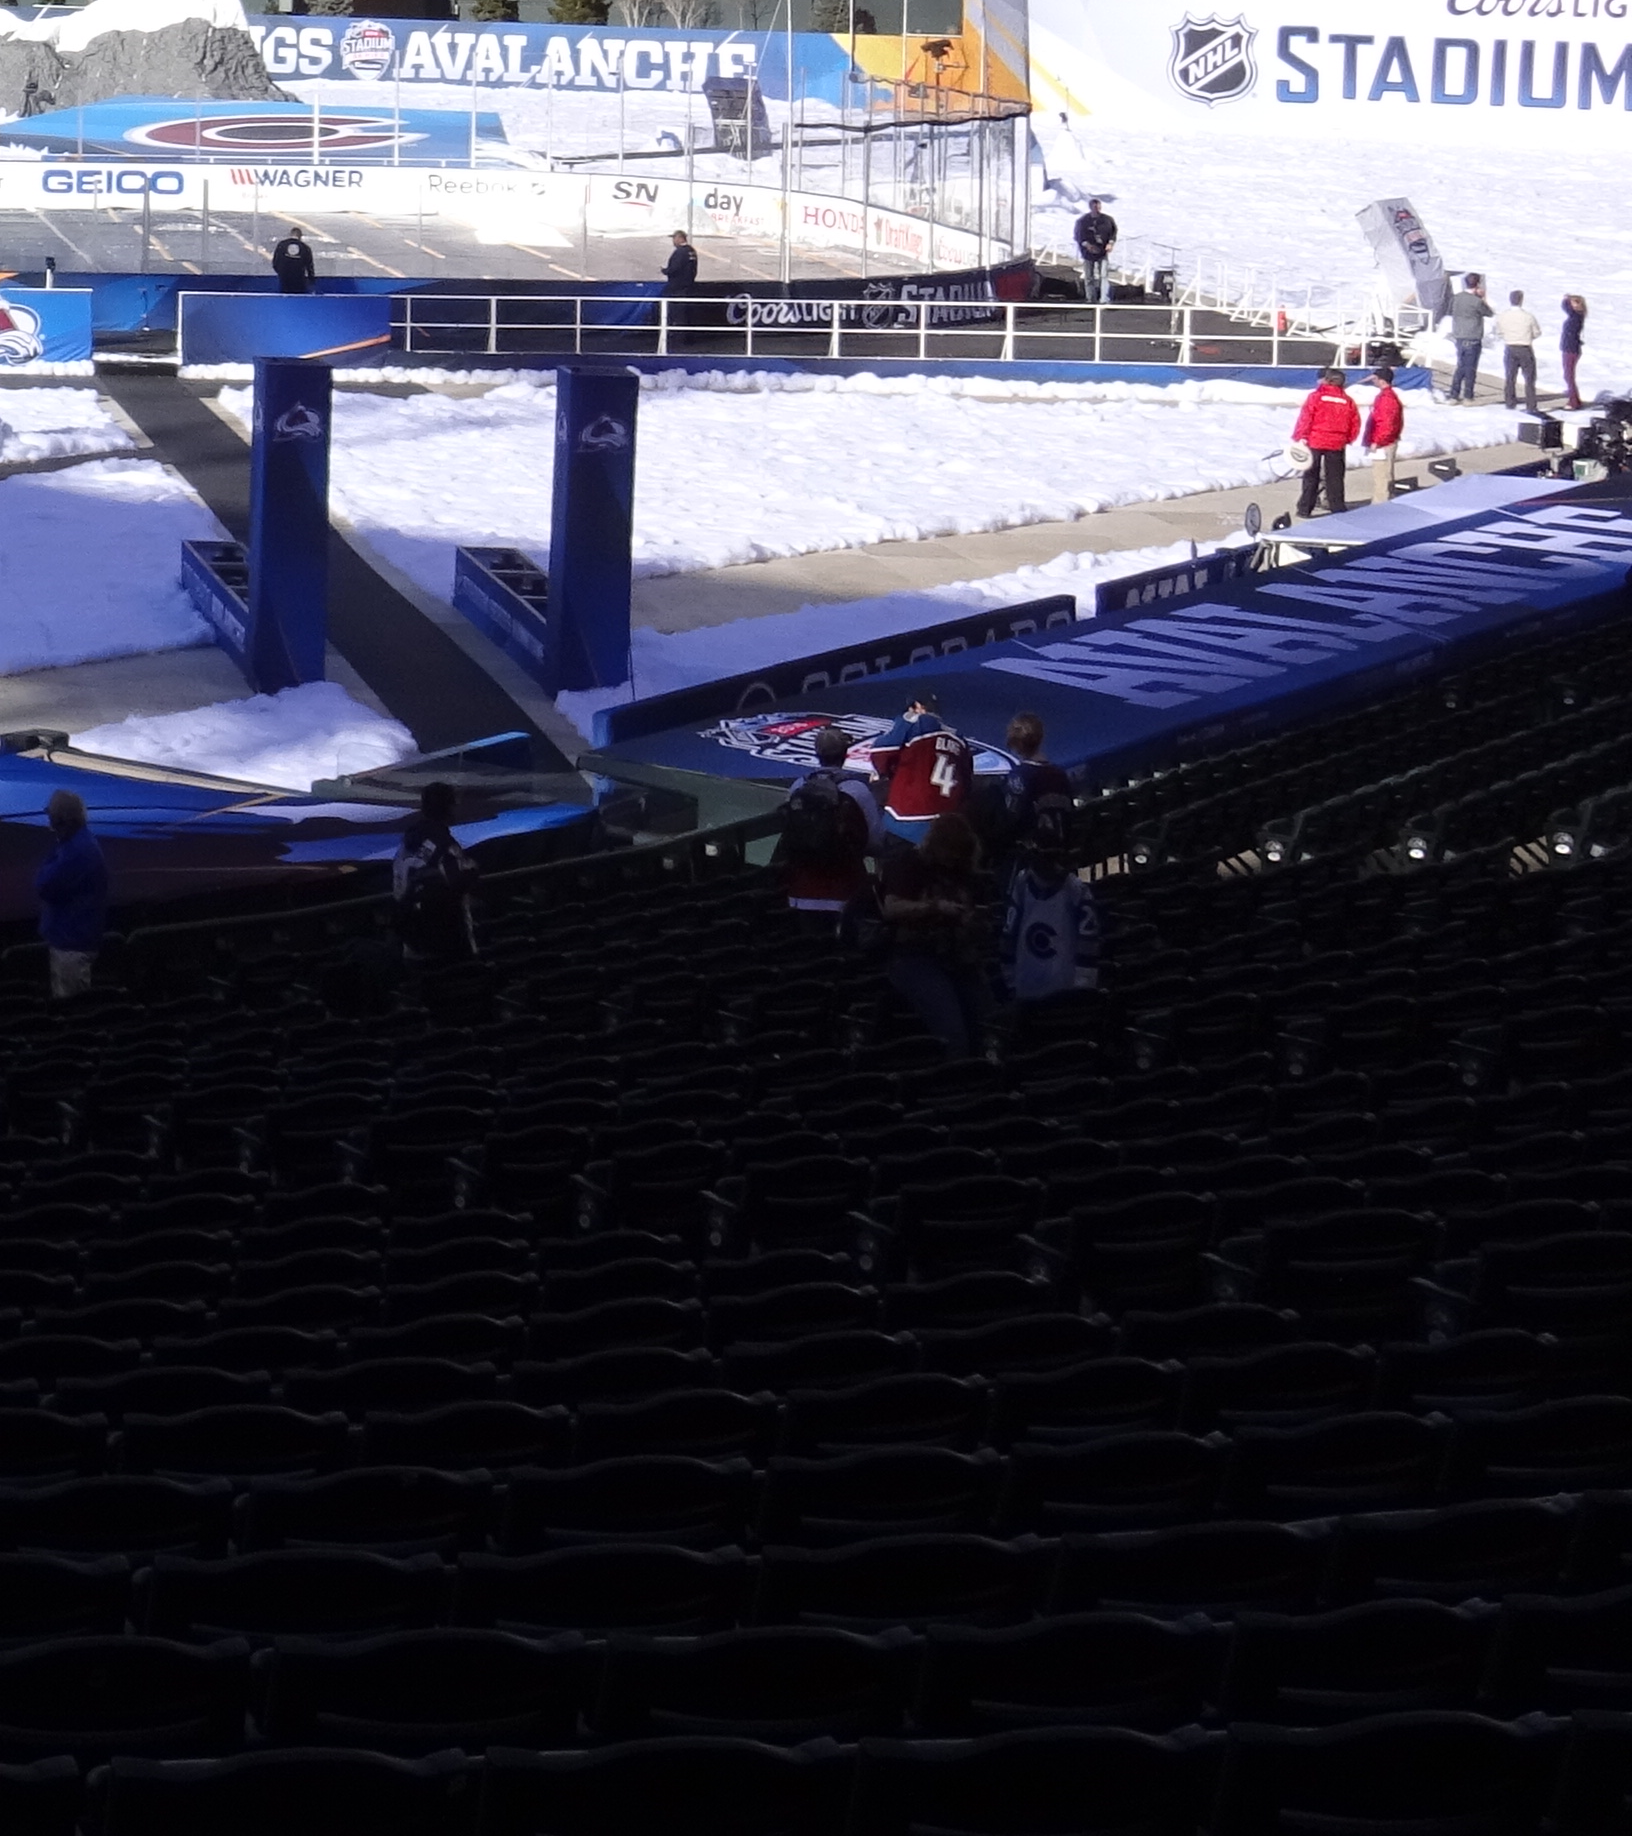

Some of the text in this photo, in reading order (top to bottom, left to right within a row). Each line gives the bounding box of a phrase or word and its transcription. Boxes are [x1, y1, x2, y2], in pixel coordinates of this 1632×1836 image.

[344, 24, 759, 93] STADIUM AVALANCHE
[1188, 37, 1239, 86] NHL
[1276, 25, 1632, 111] STADIUM
[41, 169, 185, 195] GEICO
[254, 168, 364, 188] WAGNER
[611, 181, 659, 204] SN
[703, 188, 744, 216] day
[726, 292, 803, 324] Coors
[930, 752, 958, 798] 4
